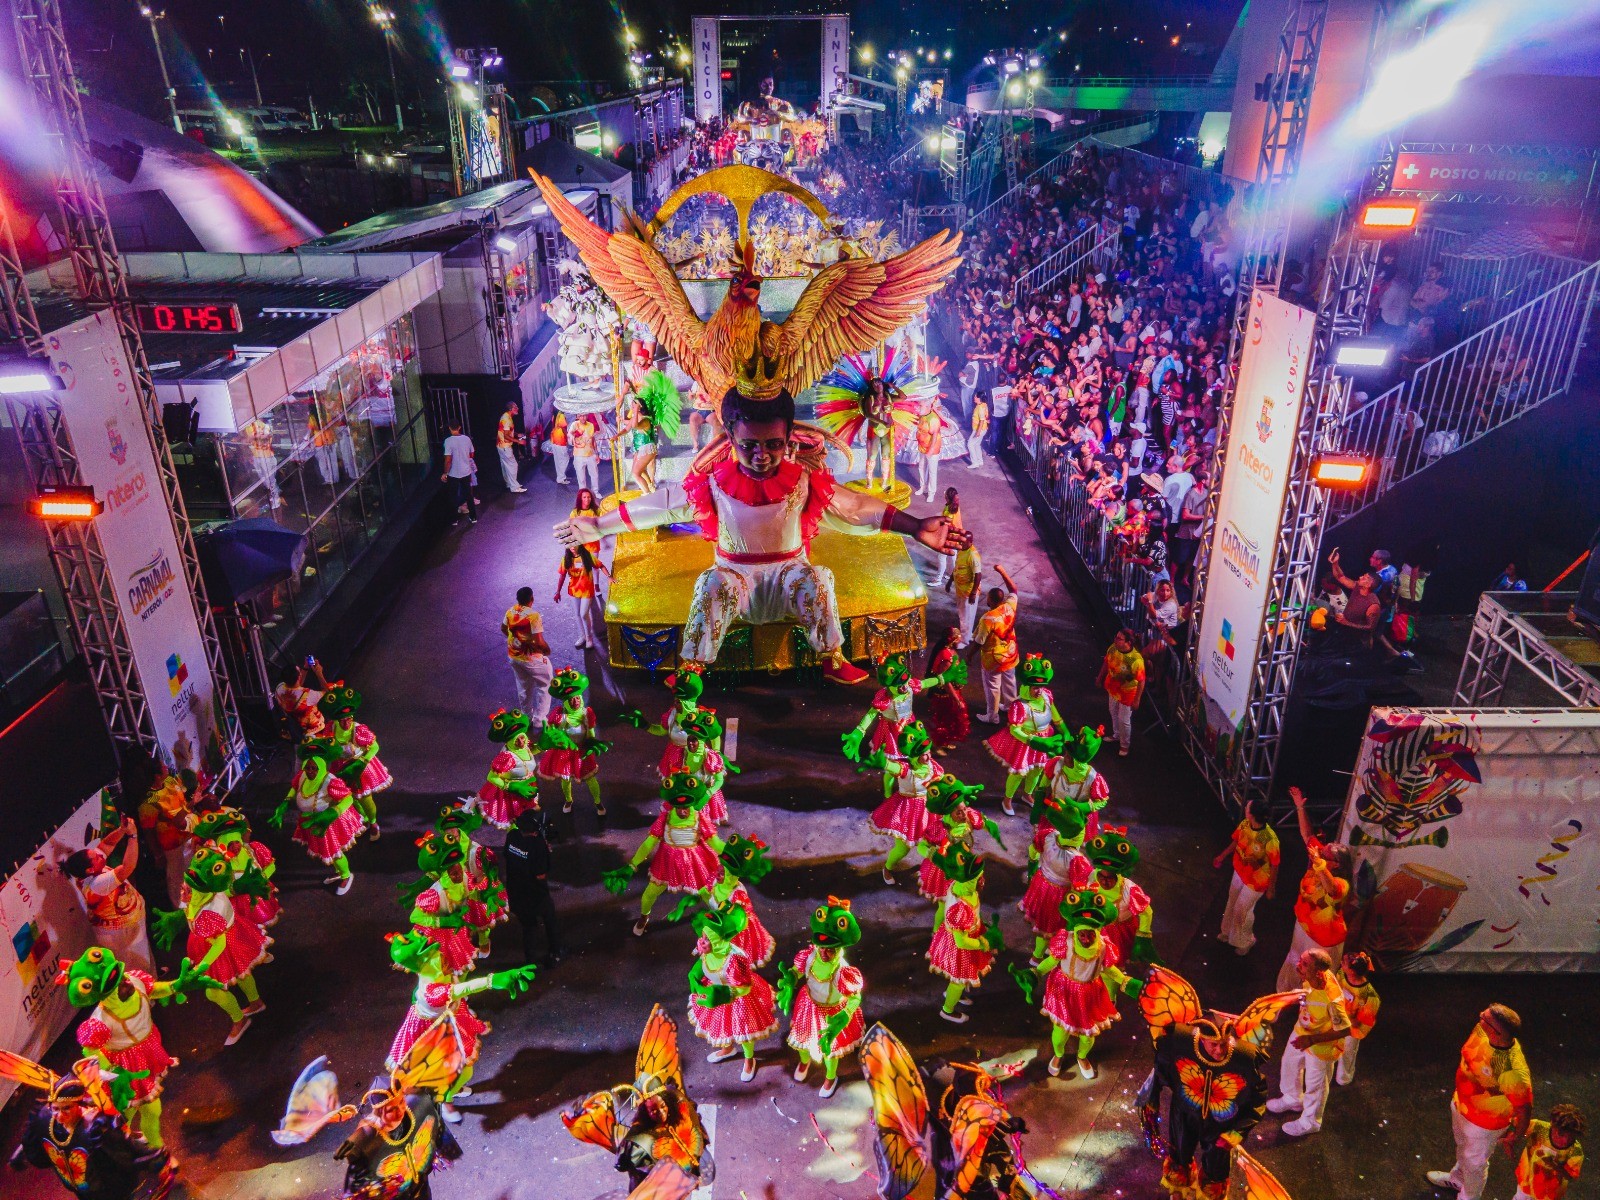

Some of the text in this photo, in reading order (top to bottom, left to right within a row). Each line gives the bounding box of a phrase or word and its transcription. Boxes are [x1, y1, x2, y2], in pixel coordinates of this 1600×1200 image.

[1429, 167, 1480, 181] POSTO
[1221, 527, 1260, 585] CARNAVAL
[128, 557, 176, 616] CARNAVAL
[1212, 650, 1235, 680] neltur
[171, 681, 195, 716] neltur
[22, 952, 61, 1013] neltur
